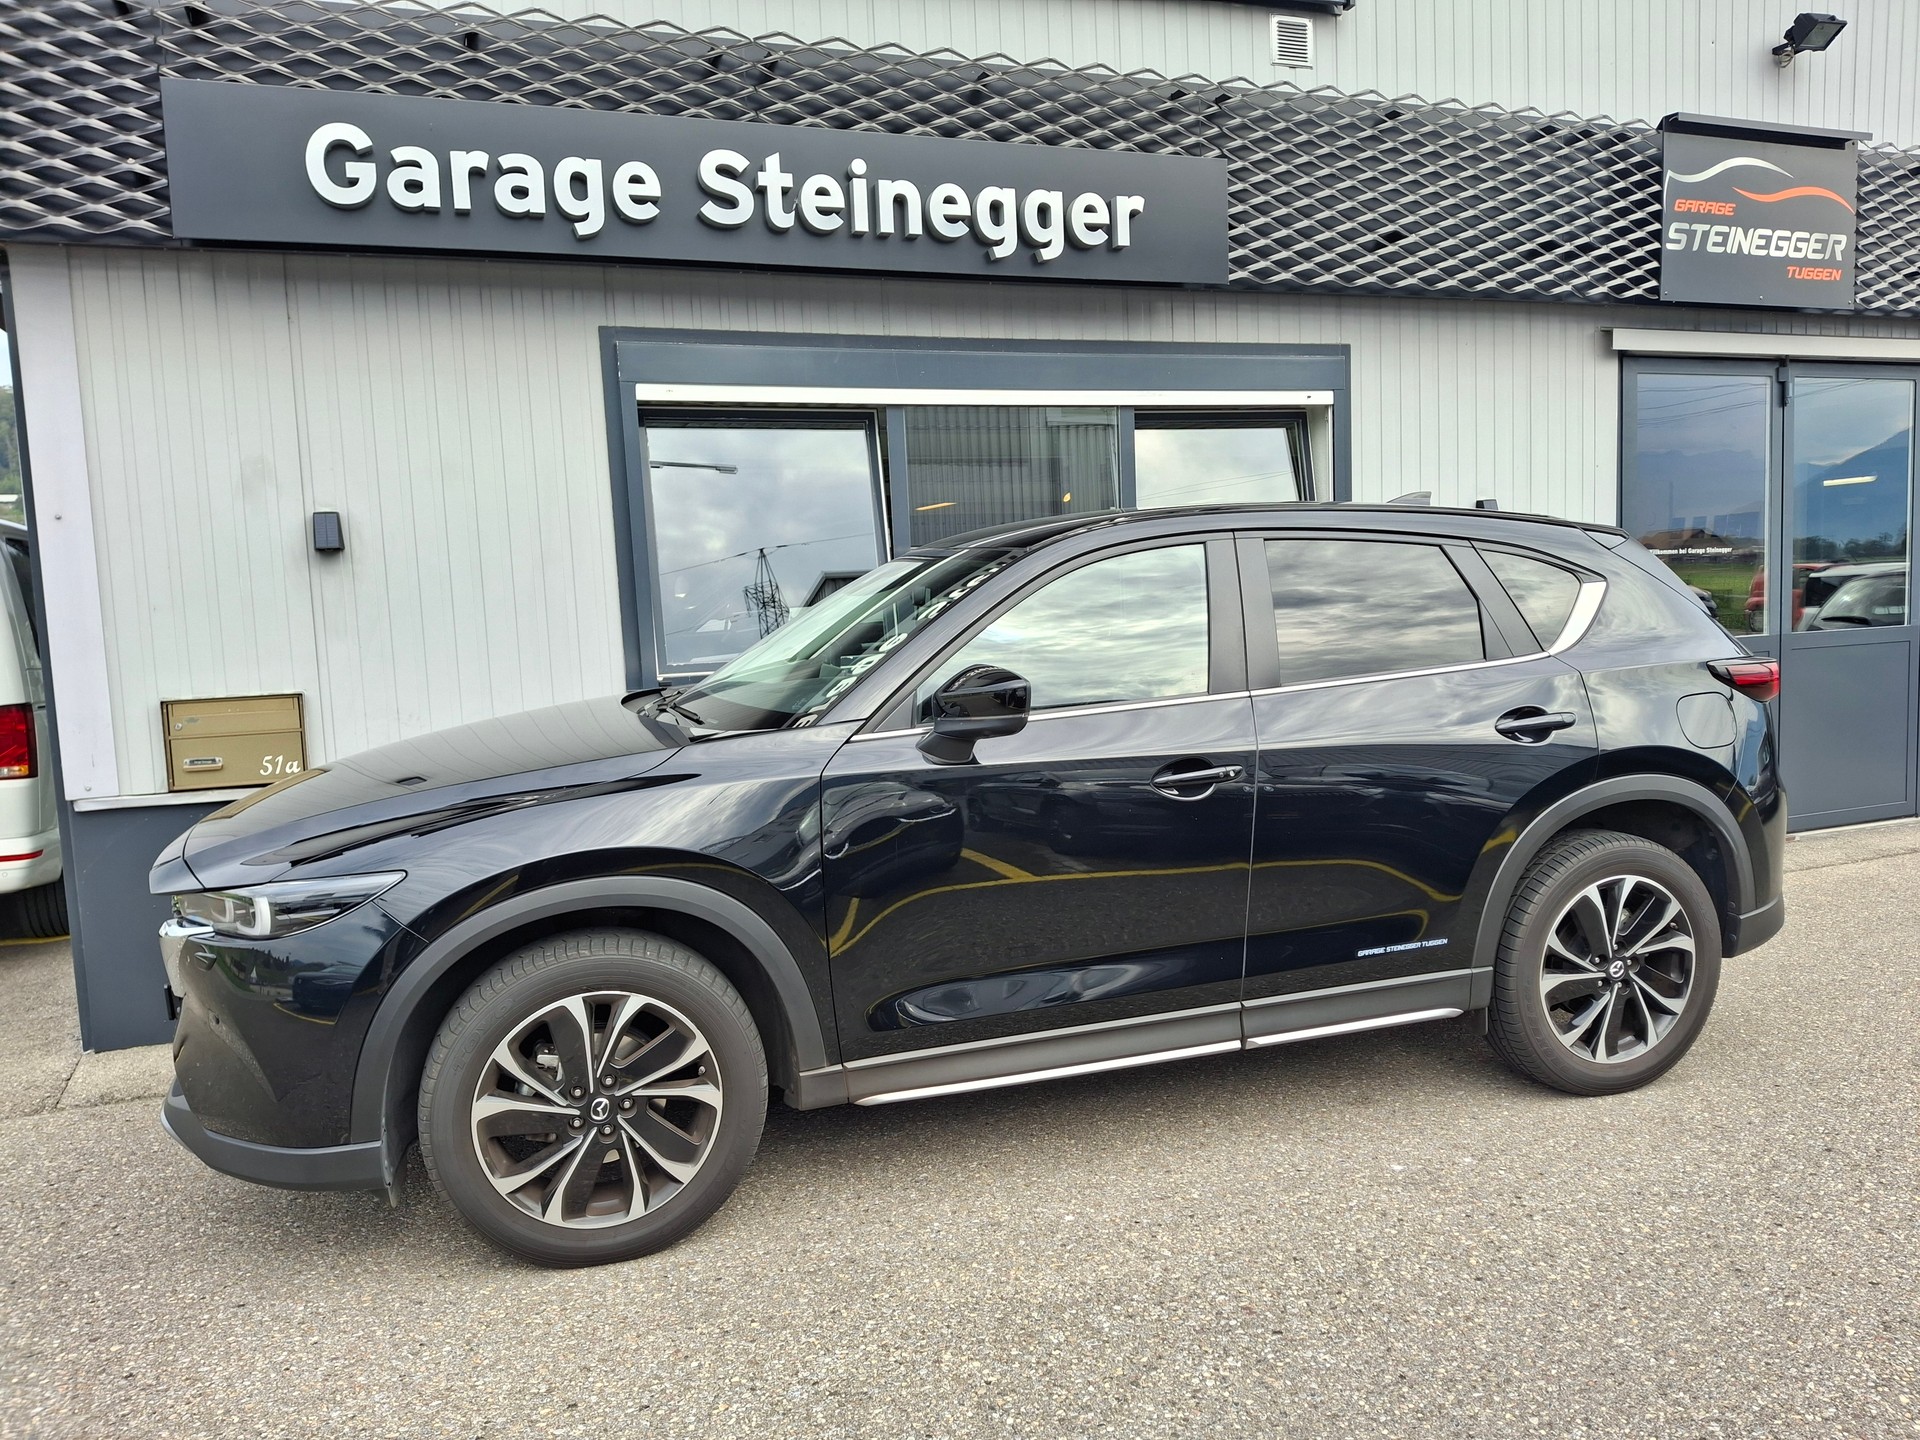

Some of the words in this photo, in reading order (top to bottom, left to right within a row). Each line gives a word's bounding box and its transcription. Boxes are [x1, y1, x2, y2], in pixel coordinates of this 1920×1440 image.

[304, 122, 663, 238] Garage
[697, 148, 1147, 263] Steinegger
[1674, 198, 1736, 216] GARAGE
[1665, 221, 1848, 262] STEINEGGER
[1786, 266, 1842, 281] TUGGEN
[1687, 547, 1705, 555] Garage
[259, 754, 301, 776] 51a
[1357, 947, 1386, 957] GARAGE
[1386, 942, 1422, 953] STEINEGGER
[1422, 938, 1448, 948] TUGGEN
